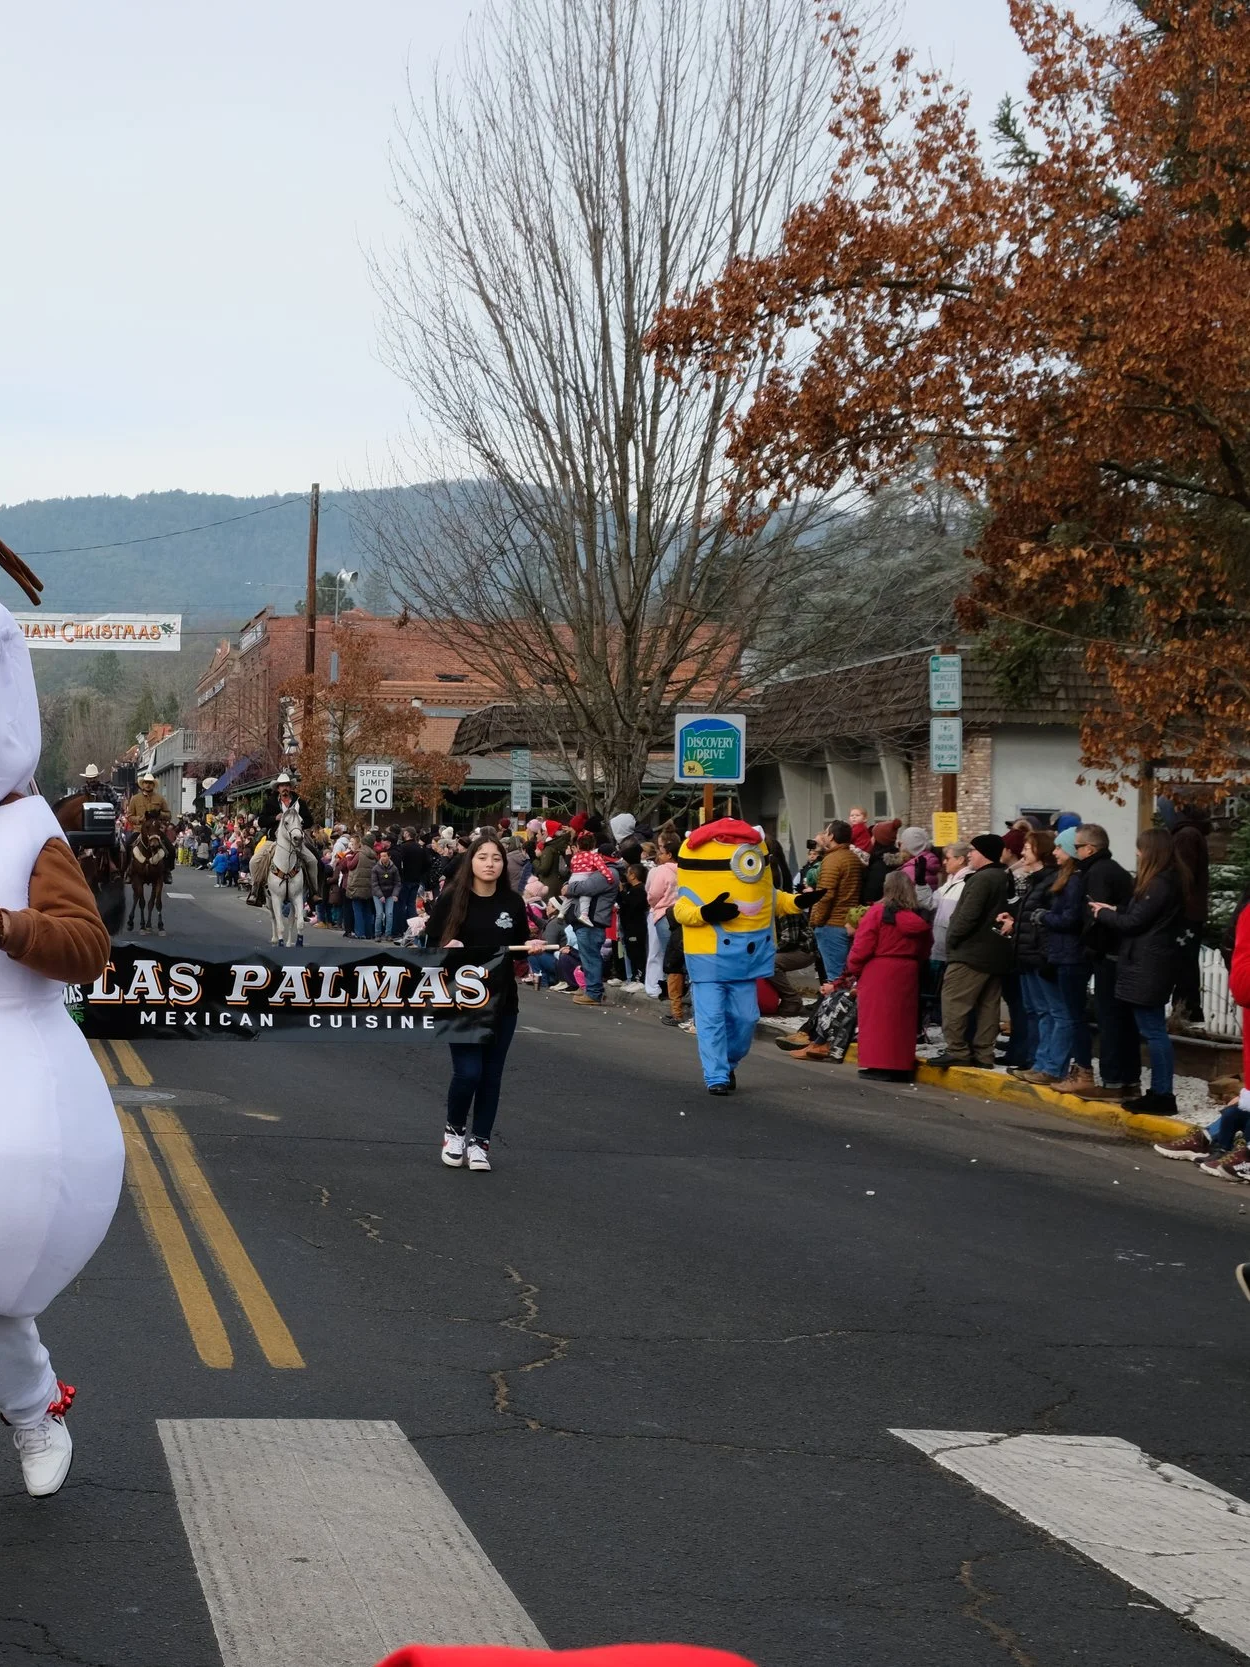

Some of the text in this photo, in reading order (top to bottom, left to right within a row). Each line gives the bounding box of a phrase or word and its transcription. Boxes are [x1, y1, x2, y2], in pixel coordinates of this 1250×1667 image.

[20, 621, 161, 644] IAN CHRISTMAS
[686, 736, 734, 748] DISCOVERY
[938, 733, 954, 742] HOUR
[934, 743, 958, 752] PARKING
[696, 749, 725, 760] DRIVE
[359, 769, 389, 777] SPEED
[360, 788, 387, 804] 20
[88, 959, 490, 1010] LAS PALMAS
[140, 1010, 435, 1030] MEXICAN CUISINE
